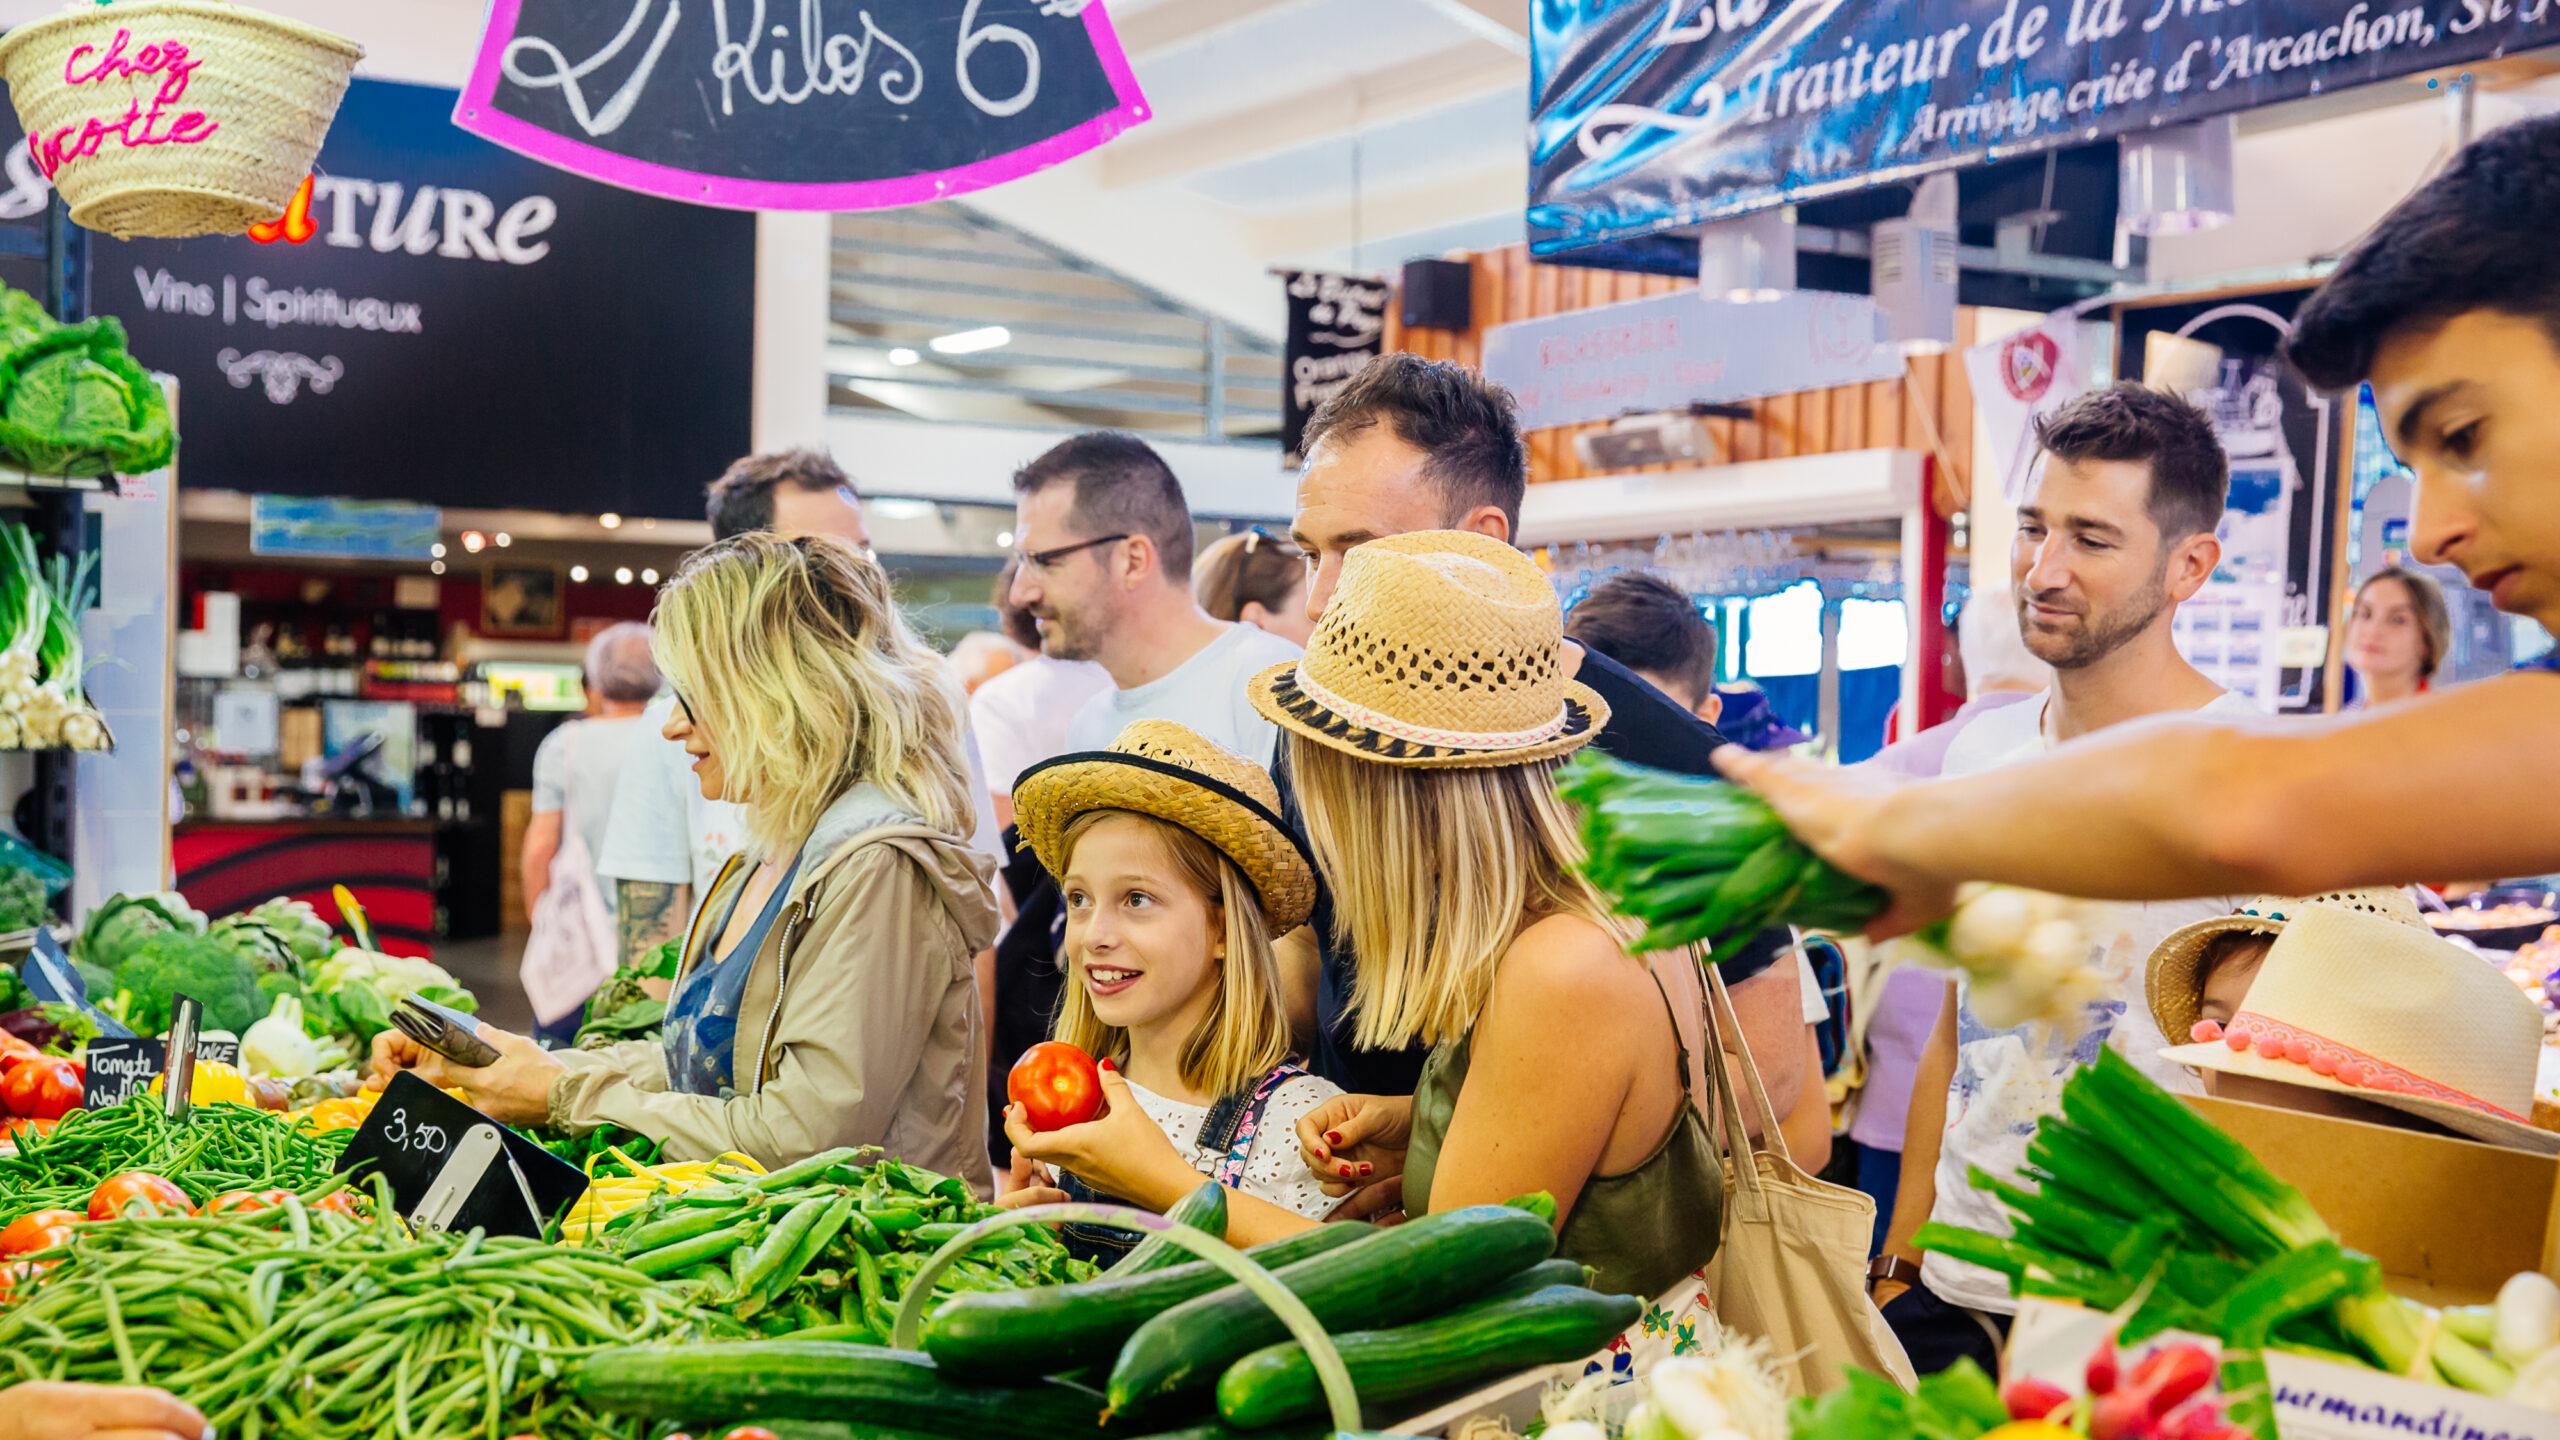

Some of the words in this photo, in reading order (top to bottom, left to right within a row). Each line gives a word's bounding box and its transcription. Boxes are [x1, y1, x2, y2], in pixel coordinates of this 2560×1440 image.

[956, 0, 1040, 116] 6
[1739, 24, 1971, 126] Traiteur
[1976, 0, 2050, 68] de
[1901, 86, 2062, 153] Arrivage
[2066, 58, 2157, 114] criée
[133, 264, 215, 317] Vins
[384, 1107, 447, 1153] 3,50
